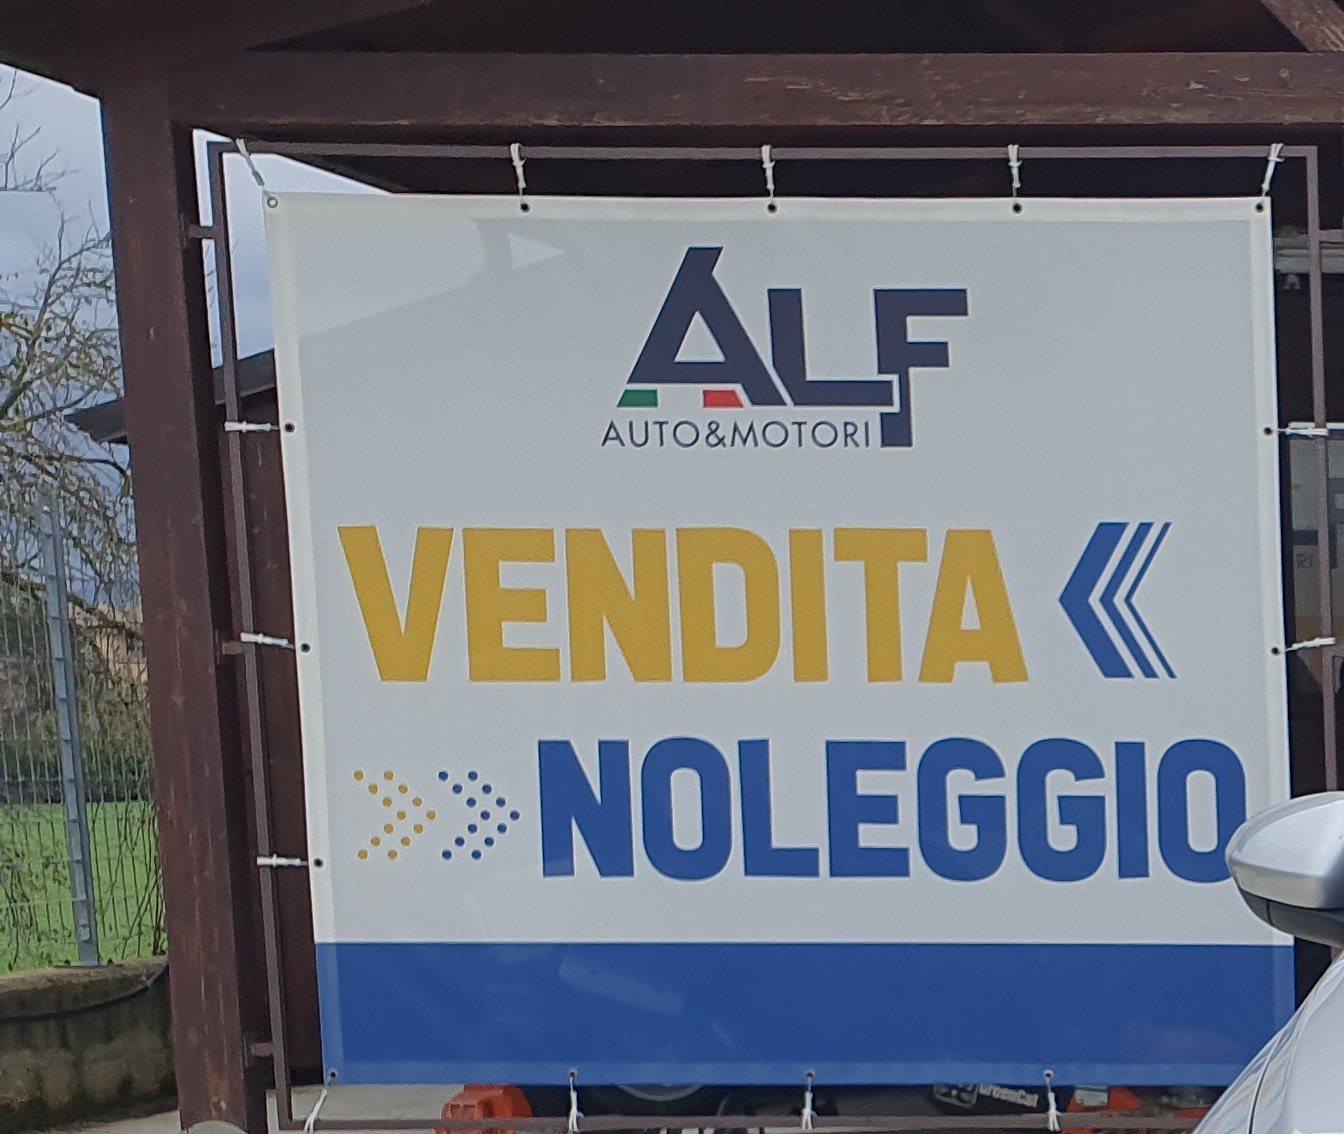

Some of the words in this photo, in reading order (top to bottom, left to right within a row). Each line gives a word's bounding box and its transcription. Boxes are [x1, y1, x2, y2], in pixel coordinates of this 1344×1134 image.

[626, 246, 968, 447] ALF
[601, 420, 870, 448] AUTO&MOTORI
[337, 524, 1029, 684] VENDITA
[537, 737, 1247, 881] NOLEGGIO
